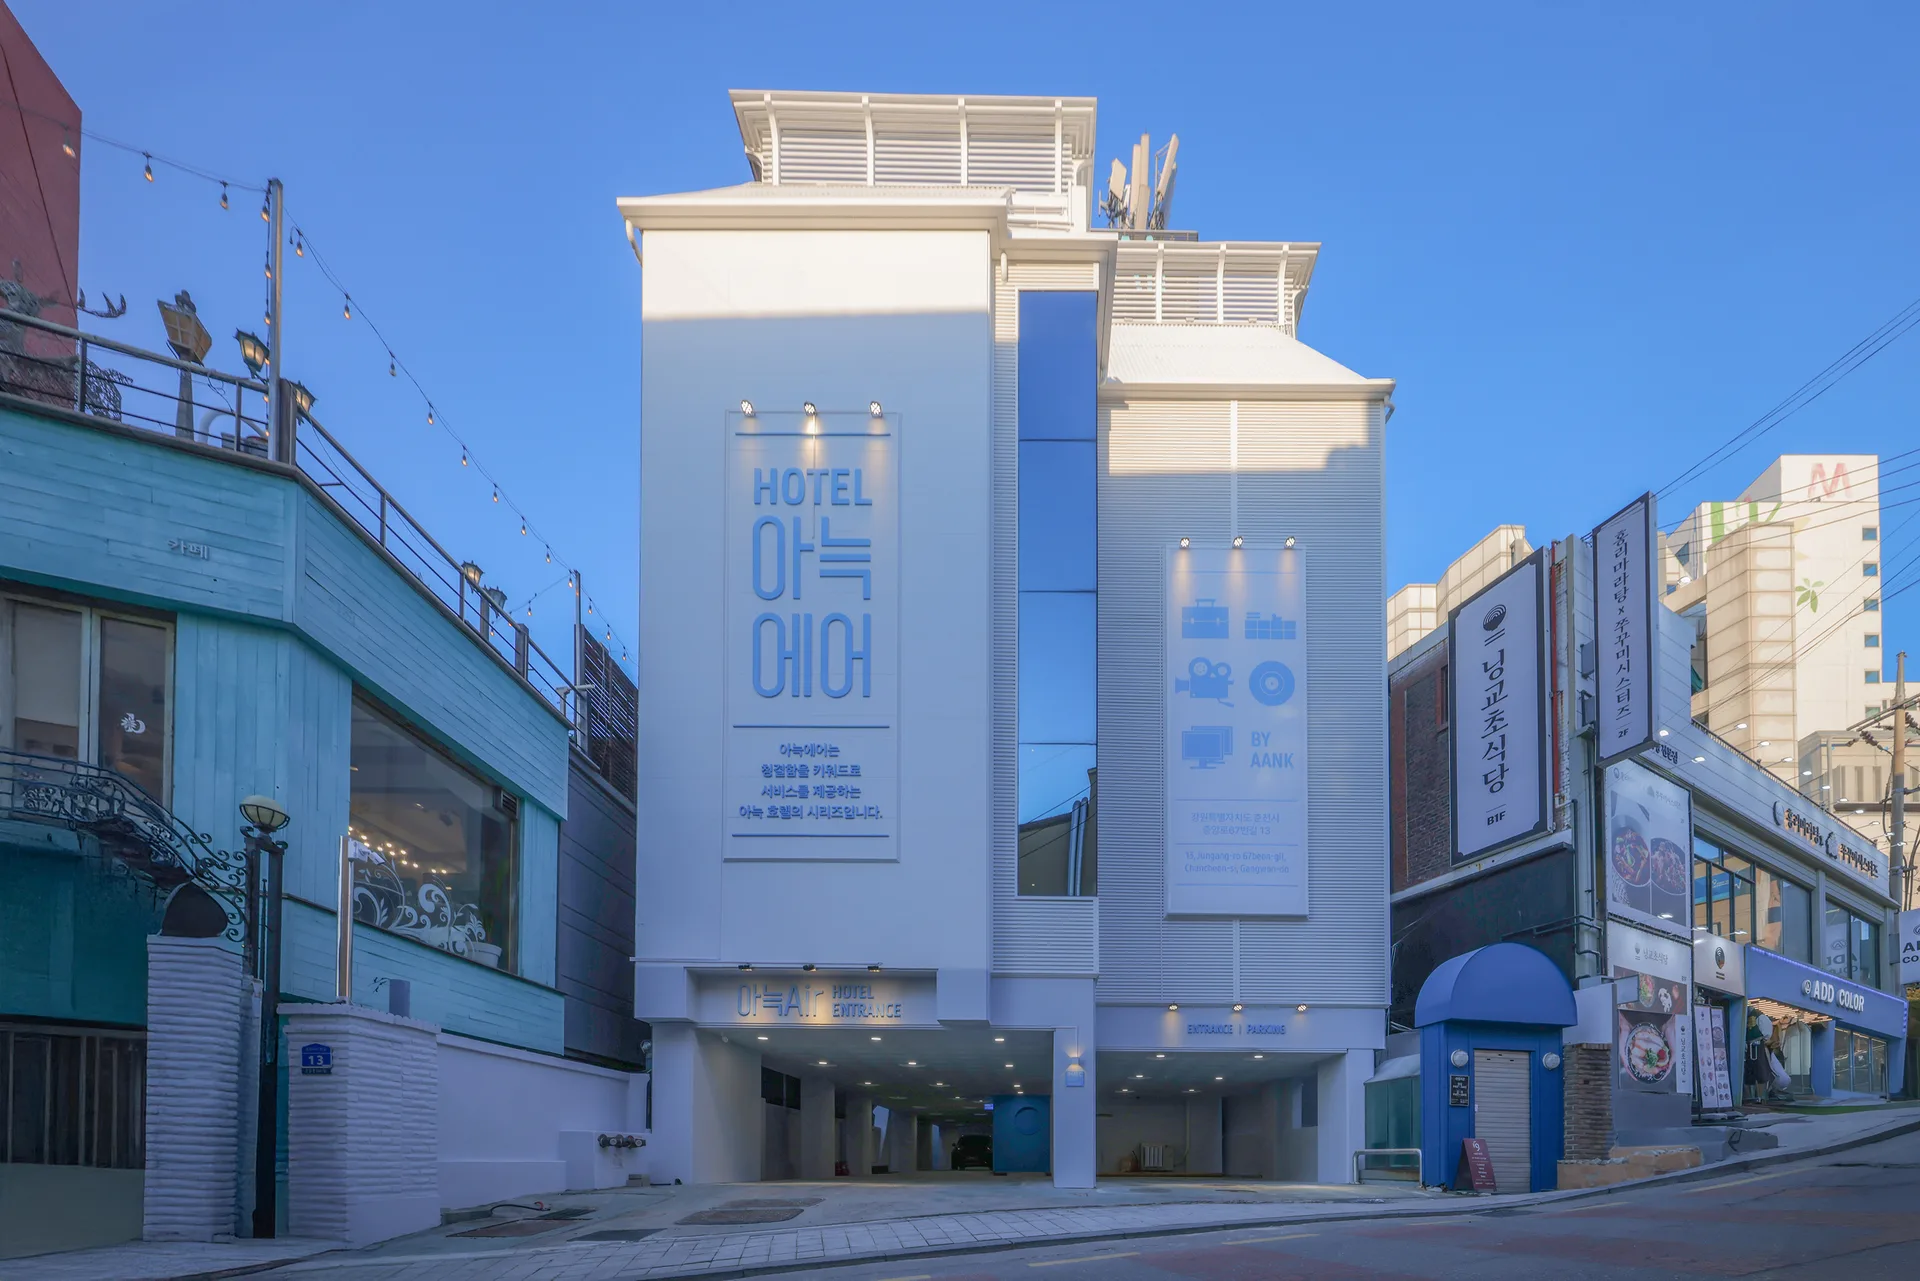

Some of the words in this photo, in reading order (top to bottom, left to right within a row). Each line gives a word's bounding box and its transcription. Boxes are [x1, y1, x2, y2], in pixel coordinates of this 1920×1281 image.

[754, 468, 872, 505] HOTEL
[753, 515, 871, 600] 아늑
[753, 612, 871, 698] 에어
[1480, 648, 1510, 794] 닝교초식당
[1251, 731, 1271, 748] BY
[779, 743, 840, 758] 아늑에어는
[1250, 753, 1294, 769] AANK
[761, 764, 810, 778] 청결함을
[813, 764, 862, 778] 키워드로
[761, 784, 810, 799] 서비스를
[812, 784, 862, 799] 제공하는
[739, 805, 764, 819] 아늑
[766, 805, 804, 819] 호텔의
[807, 805, 883, 820] 시리즈입니다.
[1487, 811, 1506, 826] B1F
[1260, 825, 1271, 835] 13
[832, 985, 875, 999] HOTEL
[1812, 980, 1835, 1003] ADD
[1838, 988, 1865, 1012] COLOR
[832, 1003, 902, 1018] ENTRANCE
[1187, 1024, 1233, 1035] ENTRANCE
[1246, 1024, 1287, 1035] PARKING
[308, 1055, 324, 1065] 13
